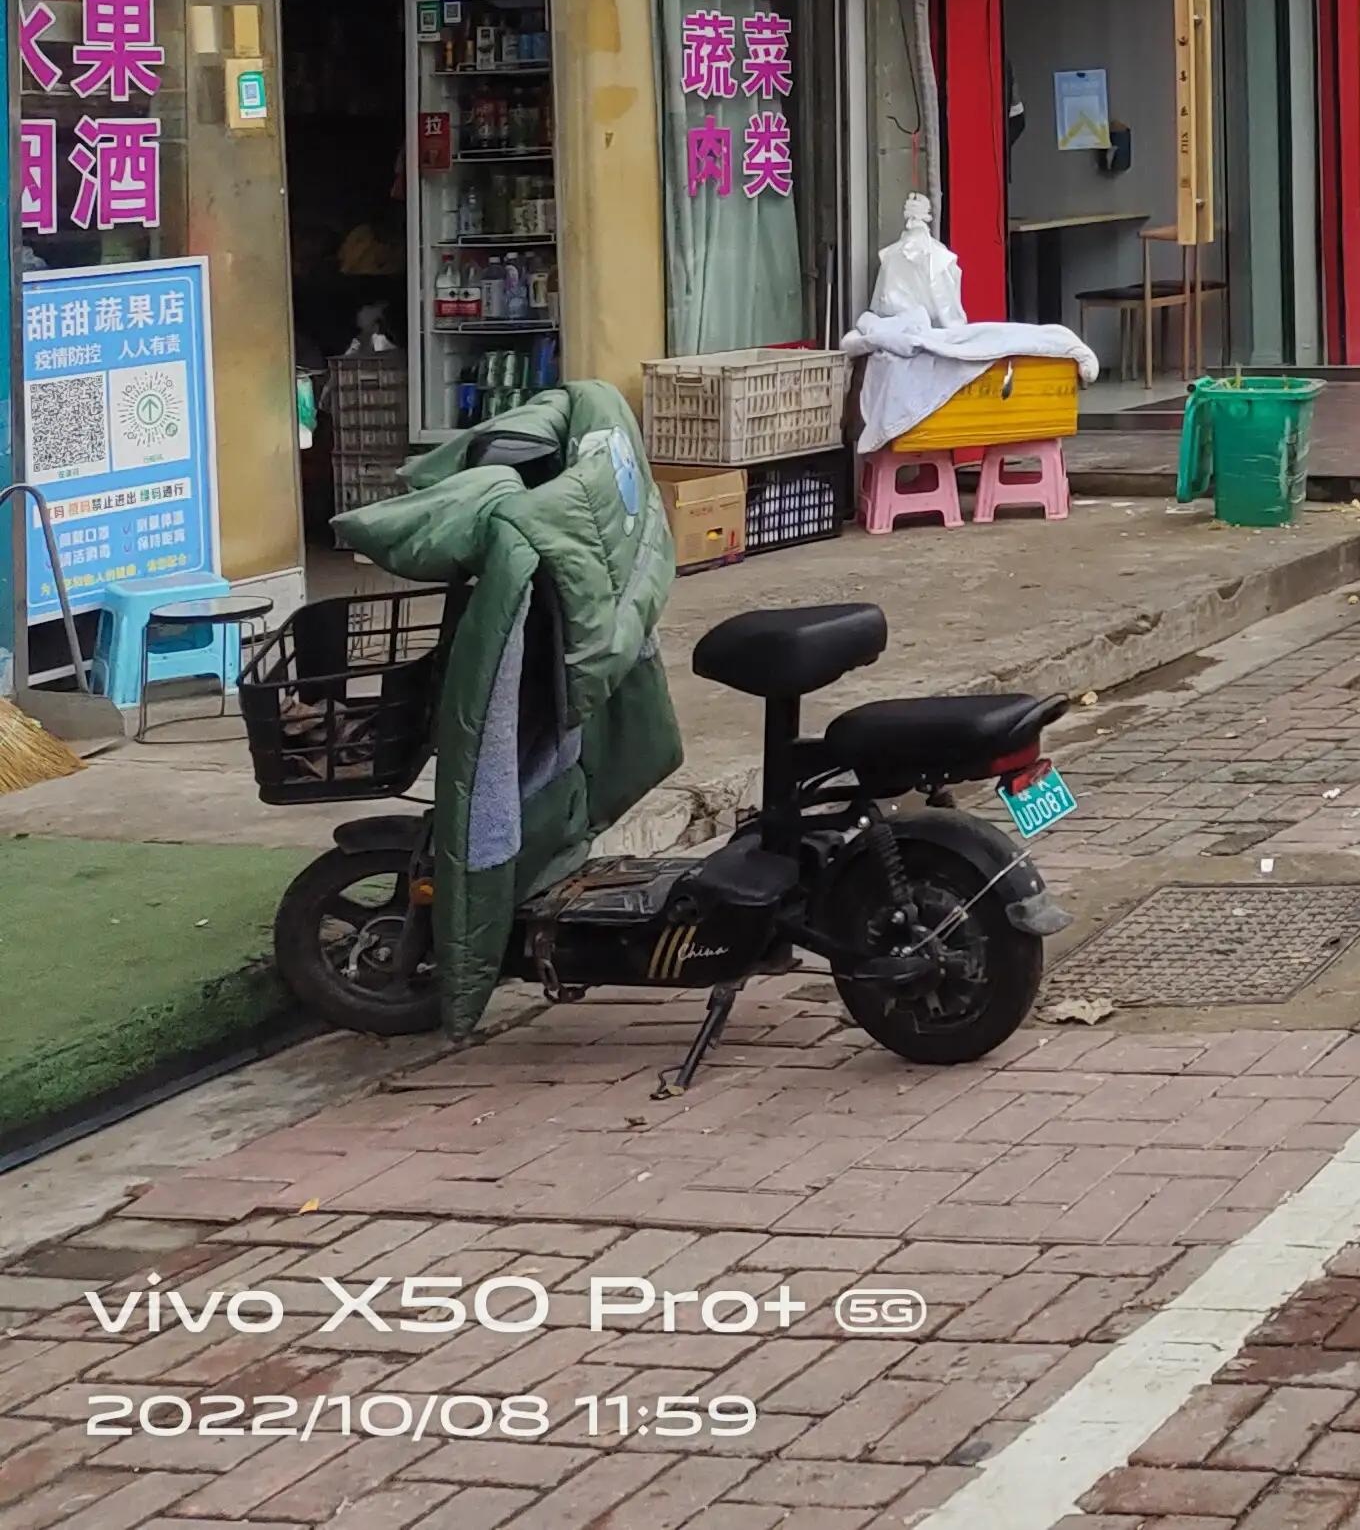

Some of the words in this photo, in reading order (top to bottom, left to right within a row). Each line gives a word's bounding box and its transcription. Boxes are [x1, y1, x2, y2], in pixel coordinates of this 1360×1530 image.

[681, 9, 794, 101] 蔬菜
[425, 117, 443, 136] 拉
[686, 111, 794, 200] 肉类
[27, 290, 186, 342] 甜甜蔬果店
[35, 343, 103, 370] 疫情防控
[117, 334, 182, 361] 人人有责
